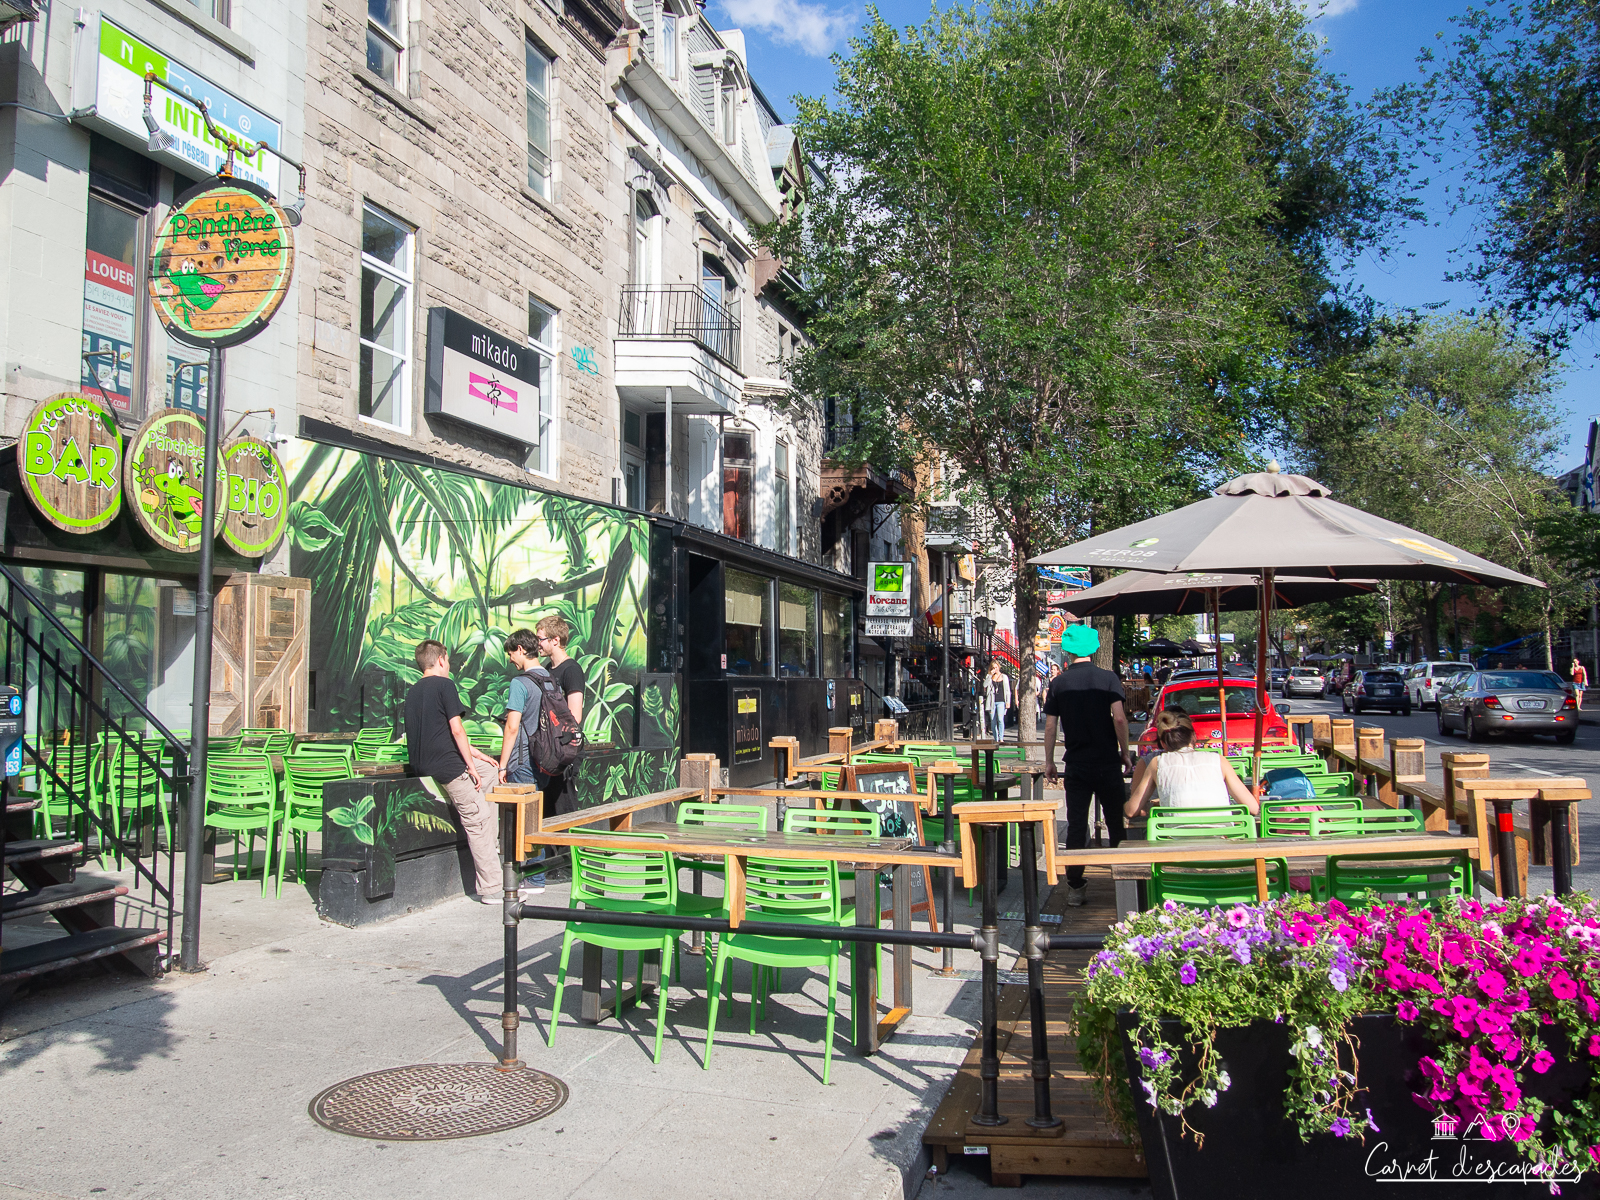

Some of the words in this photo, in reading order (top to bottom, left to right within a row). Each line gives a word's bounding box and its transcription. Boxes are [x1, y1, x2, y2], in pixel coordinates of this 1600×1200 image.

[165, 96, 267, 172] INTERNET
[182, 140, 210, 168] réseau
[216, 200, 230, 213] La
[170, 210, 275, 244] Panthère
[222, 237, 281, 261] Verte
[92, 259, 134, 287] LOUER
[471, 333, 518, 372] mikado
[87, 392, 127, 409] OTLO.COM
[157, 421, 168, 435] La
[147, 429, 206, 460] Panthère
[24, 431, 118, 491] BAR
[190, 458, 227, 482] Vte
[228, 473, 281, 520] BIO
[1088, 548, 1158, 558] ZERO8
[869, 594, 907, 605] Koreana
[736, 724, 760, 743] mikado
[12, 747, 20, 759] G
